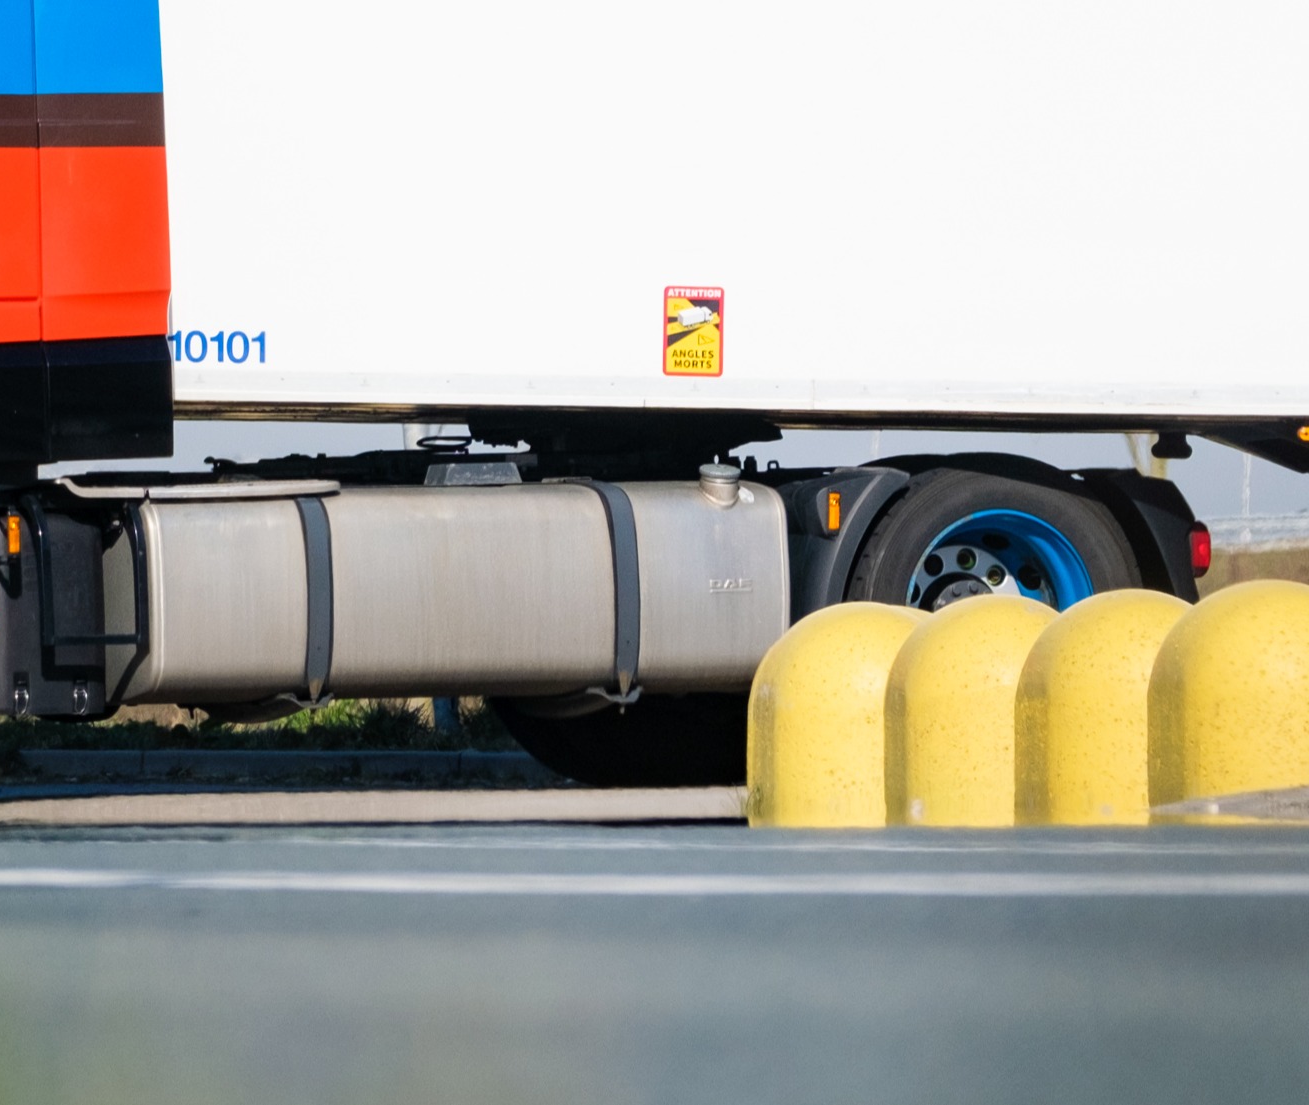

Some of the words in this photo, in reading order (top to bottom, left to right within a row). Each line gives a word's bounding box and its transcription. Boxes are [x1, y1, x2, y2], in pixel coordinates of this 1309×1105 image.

[667, 288, 722, 298] ATTENTION
[168, 330, 266, 364] 10101
[672, 349, 714, 359] ANGLES
[674, 360, 712, 369] MORTS
